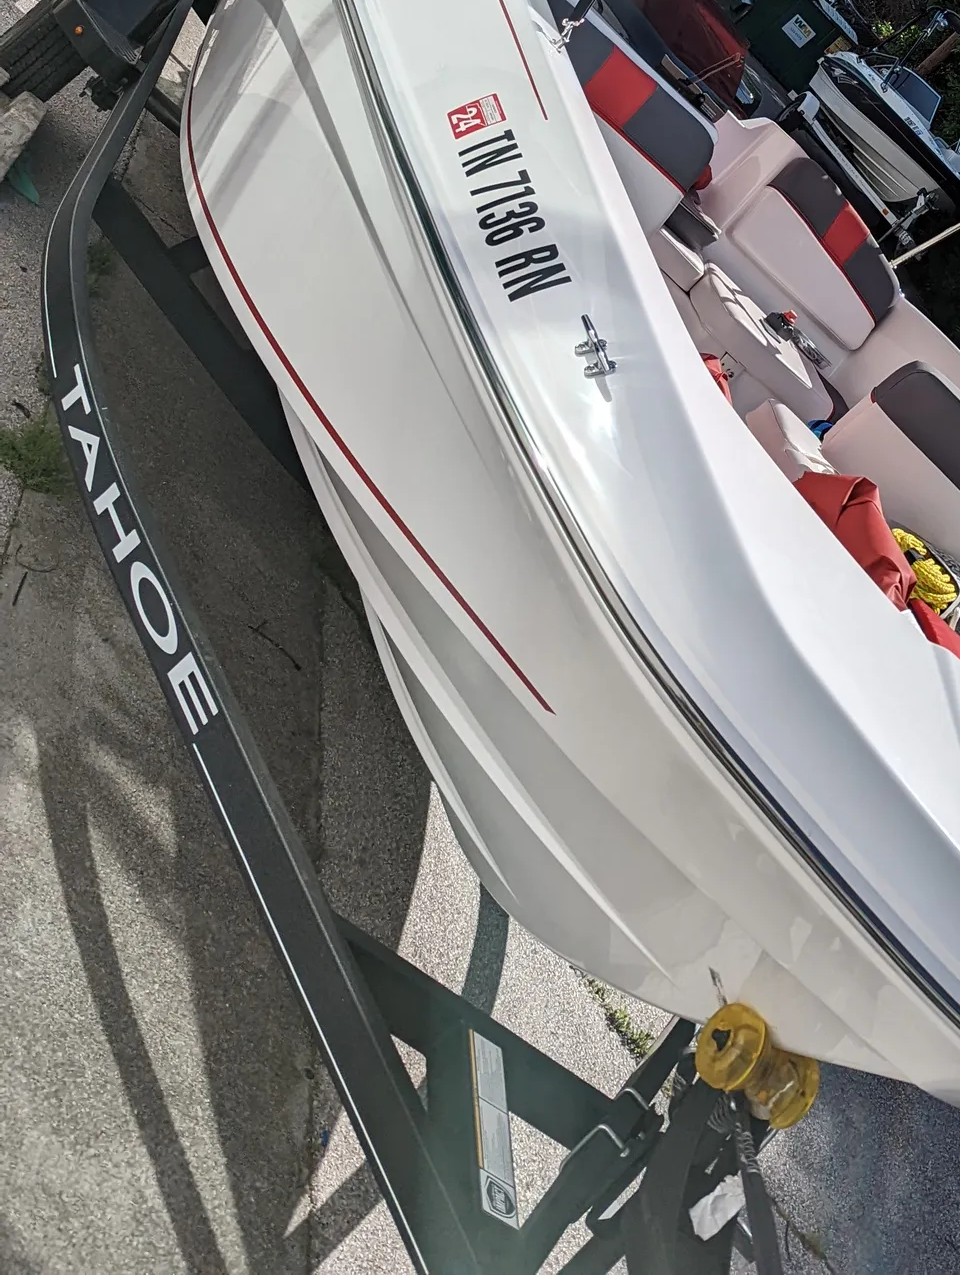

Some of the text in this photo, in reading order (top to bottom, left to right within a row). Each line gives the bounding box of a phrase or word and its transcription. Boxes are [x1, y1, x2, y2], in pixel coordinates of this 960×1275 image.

[450, 107, 481, 133] 24
[458, 129, 572, 302] TN 7136 RN
[61, 363, 219, 735] TAHOE
